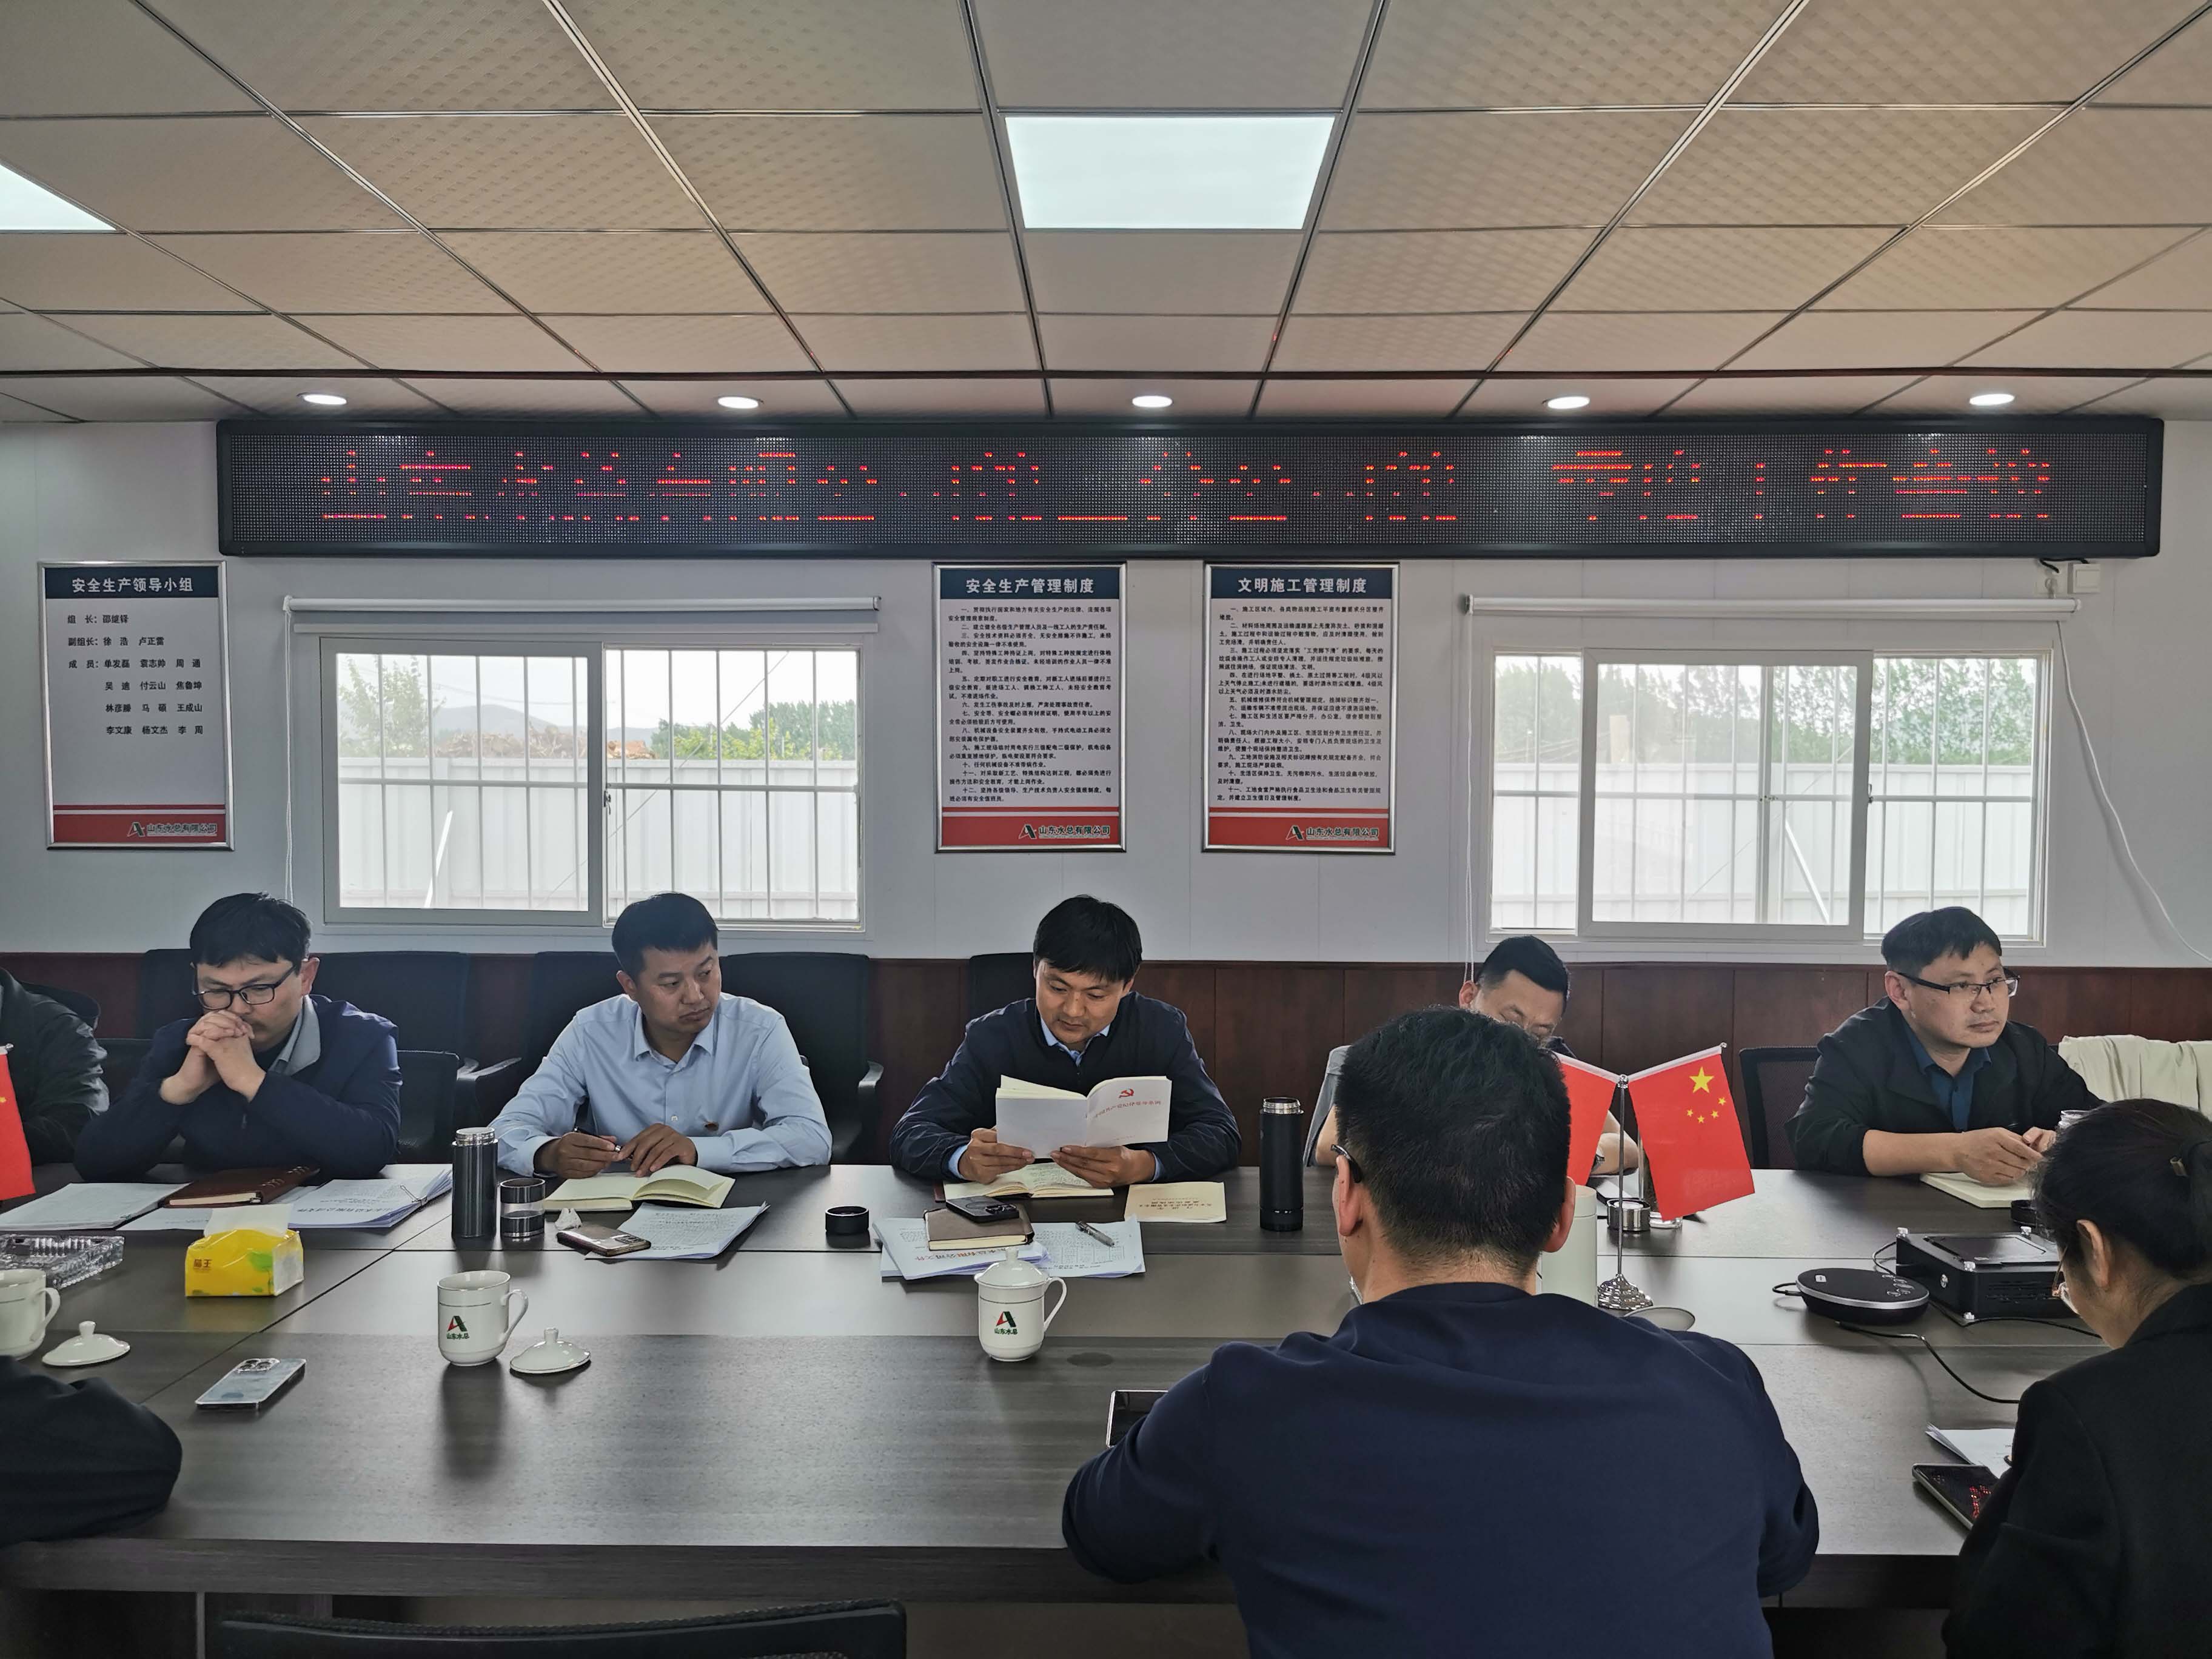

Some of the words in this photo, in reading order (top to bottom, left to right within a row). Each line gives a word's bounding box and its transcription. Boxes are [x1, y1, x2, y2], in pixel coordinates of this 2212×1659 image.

[72, 578, 193, 593] 安全生产领导小组
[966, 578, 1094, 594] 安全生产管理制度
[1238, 578, 1367, 593] 文明施工管理制度
[1039, 825, 1111, 834] 山东水总有限公司
[1307, 827, 1379, 836] 山东水总有限公司
